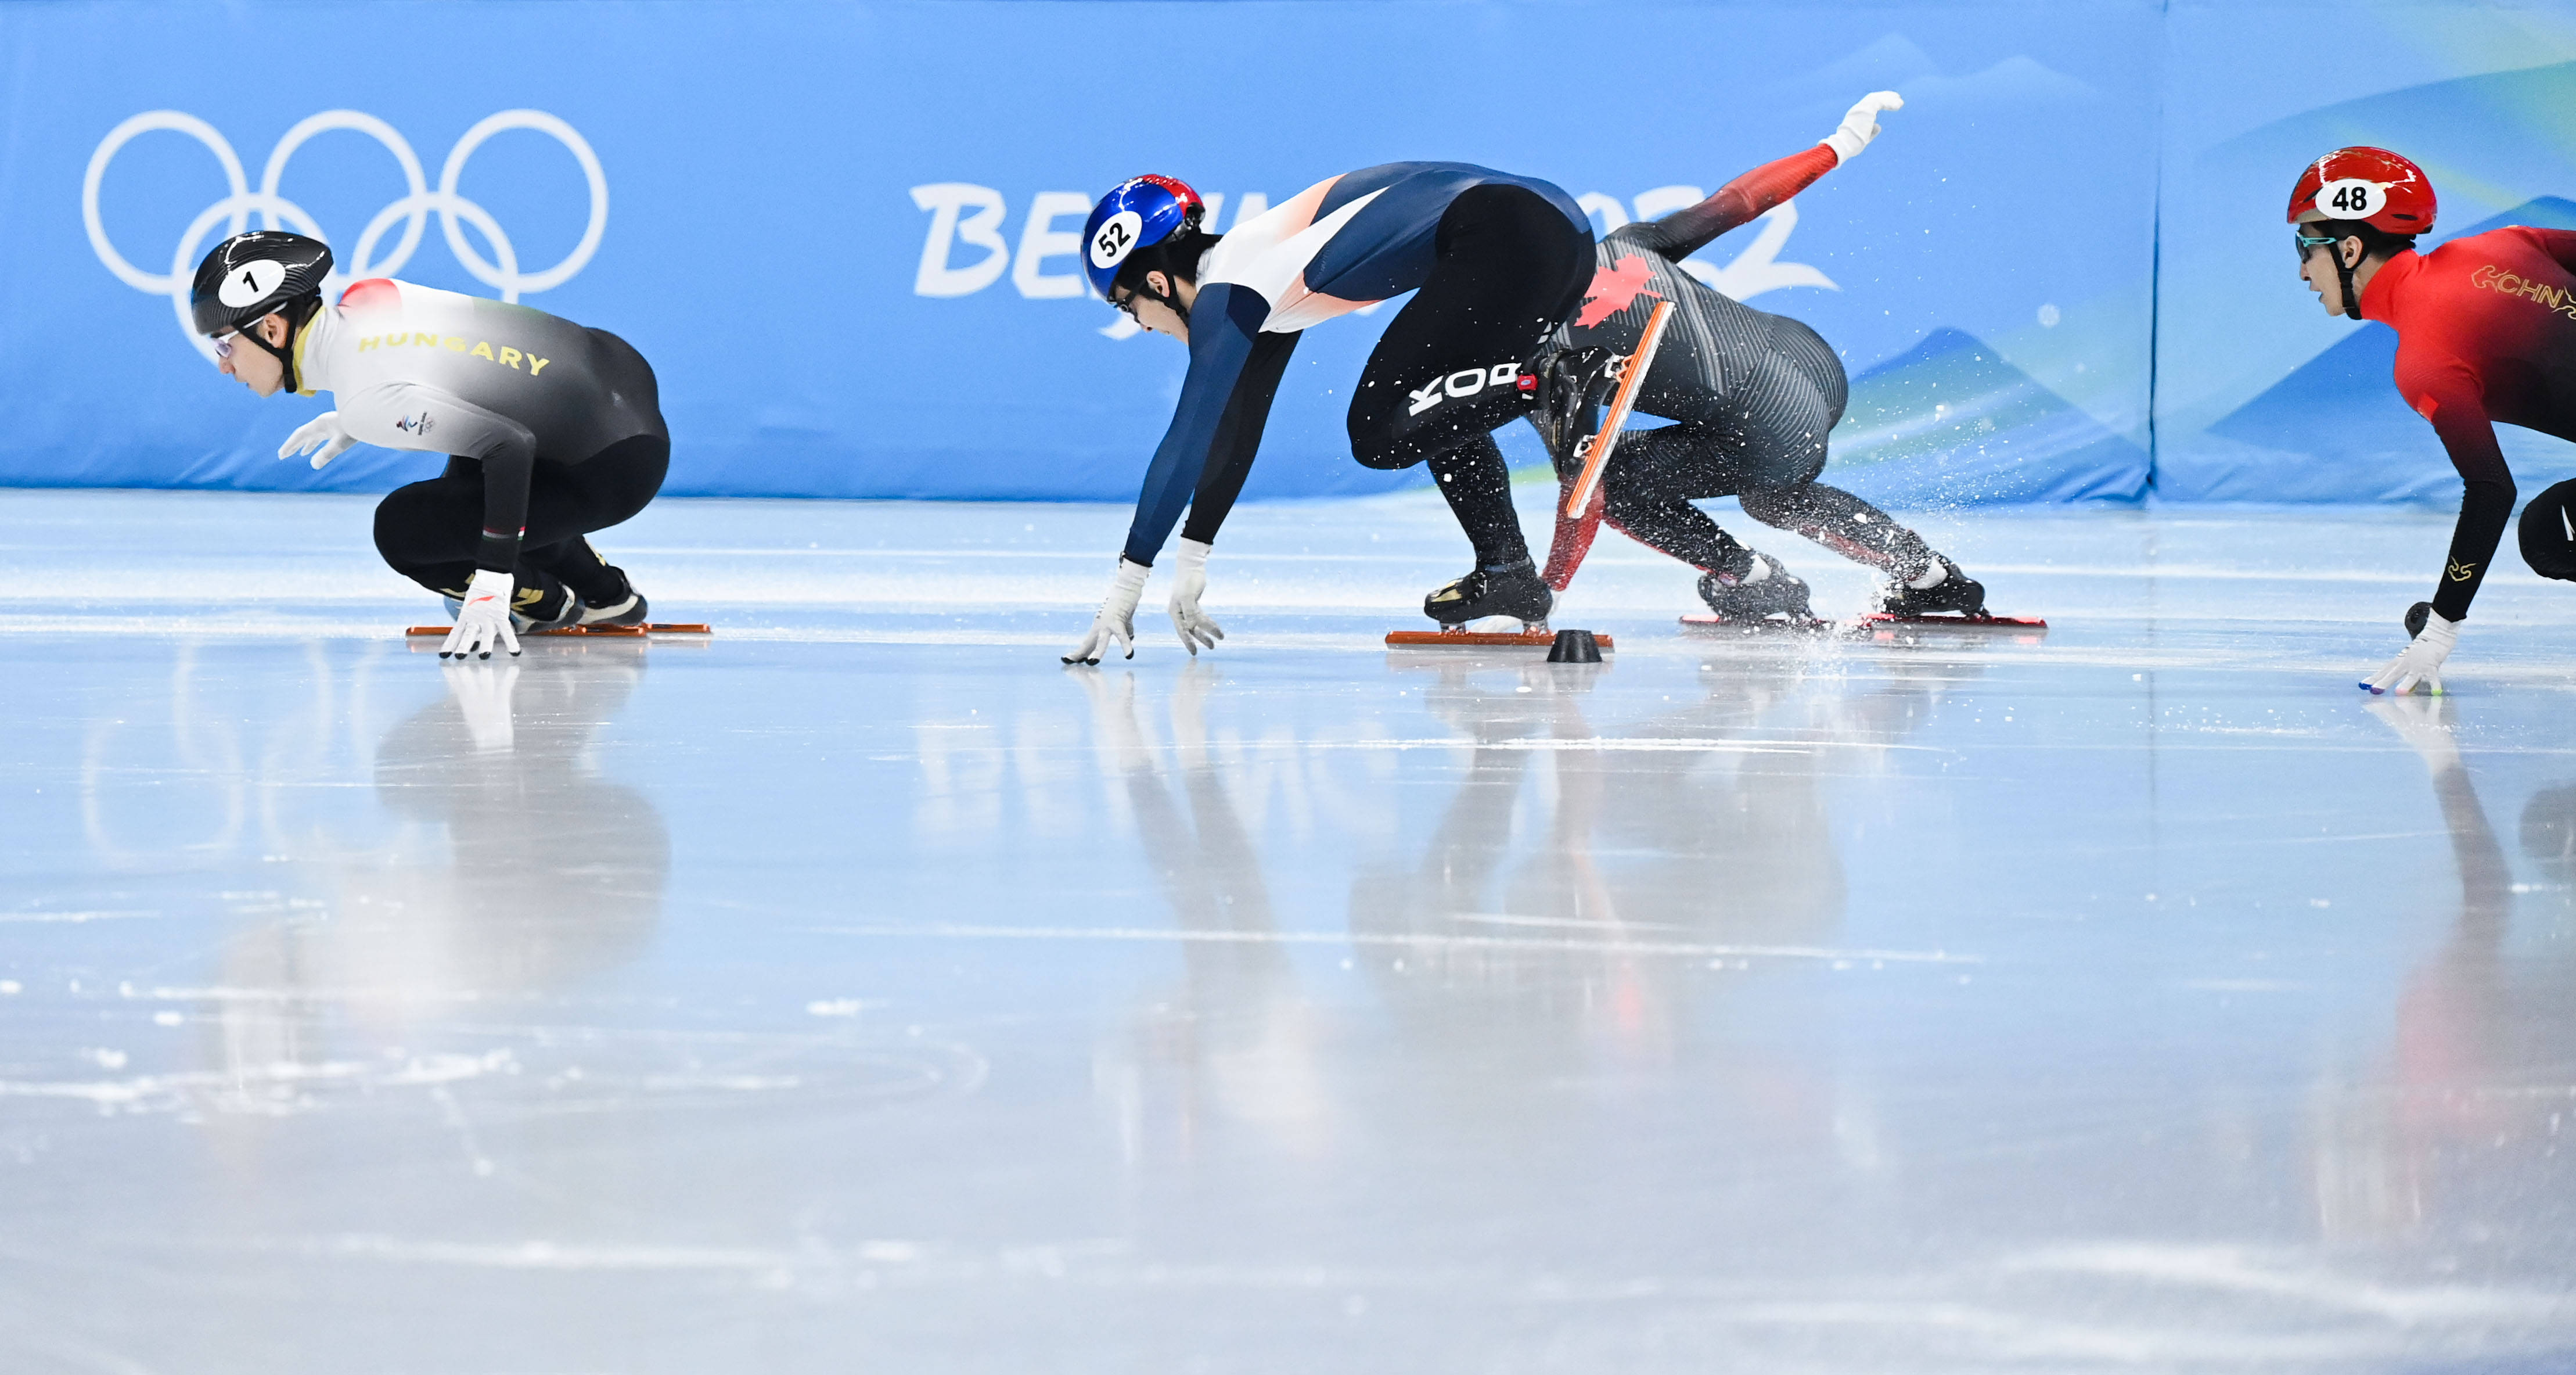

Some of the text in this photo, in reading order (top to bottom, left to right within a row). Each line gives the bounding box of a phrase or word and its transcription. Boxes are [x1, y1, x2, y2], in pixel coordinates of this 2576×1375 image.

[2332, 186, 2367, 211] 48
[1098, 222, 1131, 257] 52
[242, 271, 259, 293] 1
[2498, 274, 2564, 308] CHN
[358, 332, 551, 376] HUNGARY
